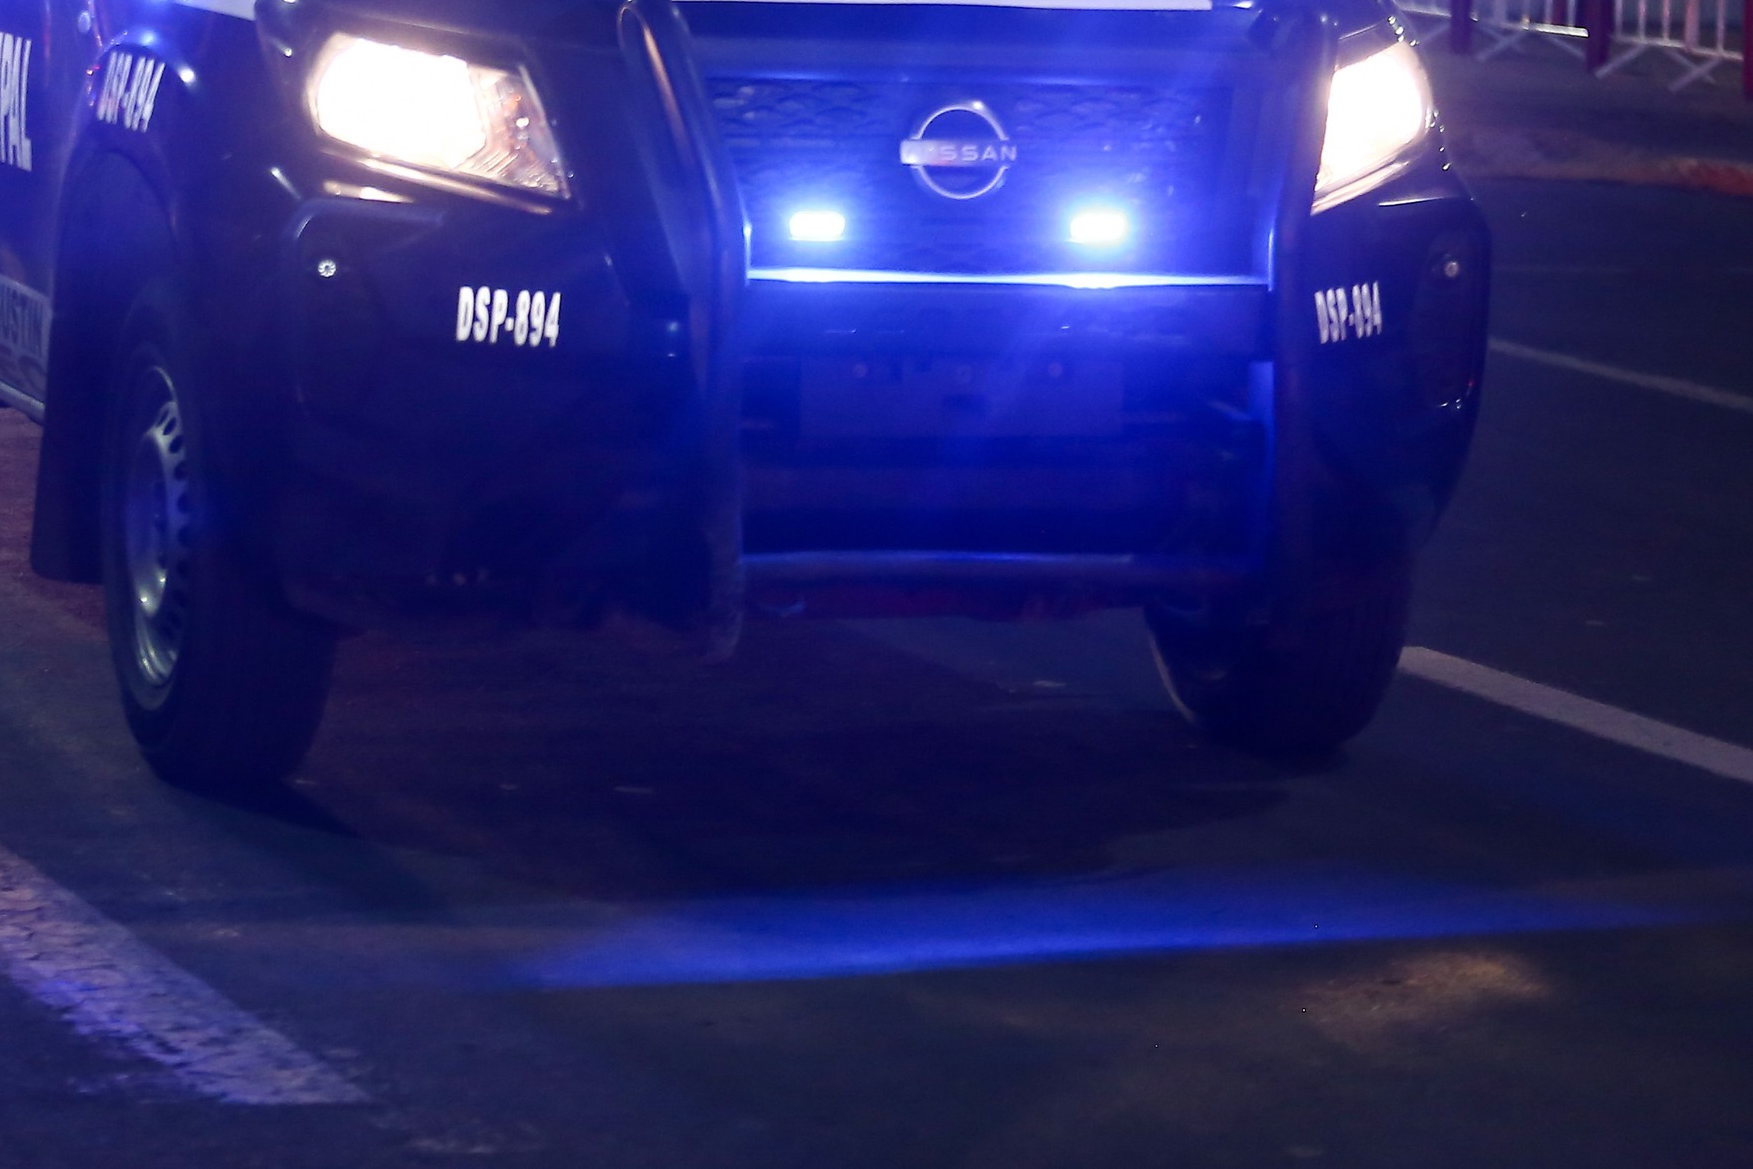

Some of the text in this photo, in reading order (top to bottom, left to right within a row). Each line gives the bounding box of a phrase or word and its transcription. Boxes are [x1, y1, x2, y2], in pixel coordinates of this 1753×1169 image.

[96, 51, 166, 133] DSP-894
[455, 285, 562, 348] DSP-894
[1314, 280, 1382, 344] DSP-894
